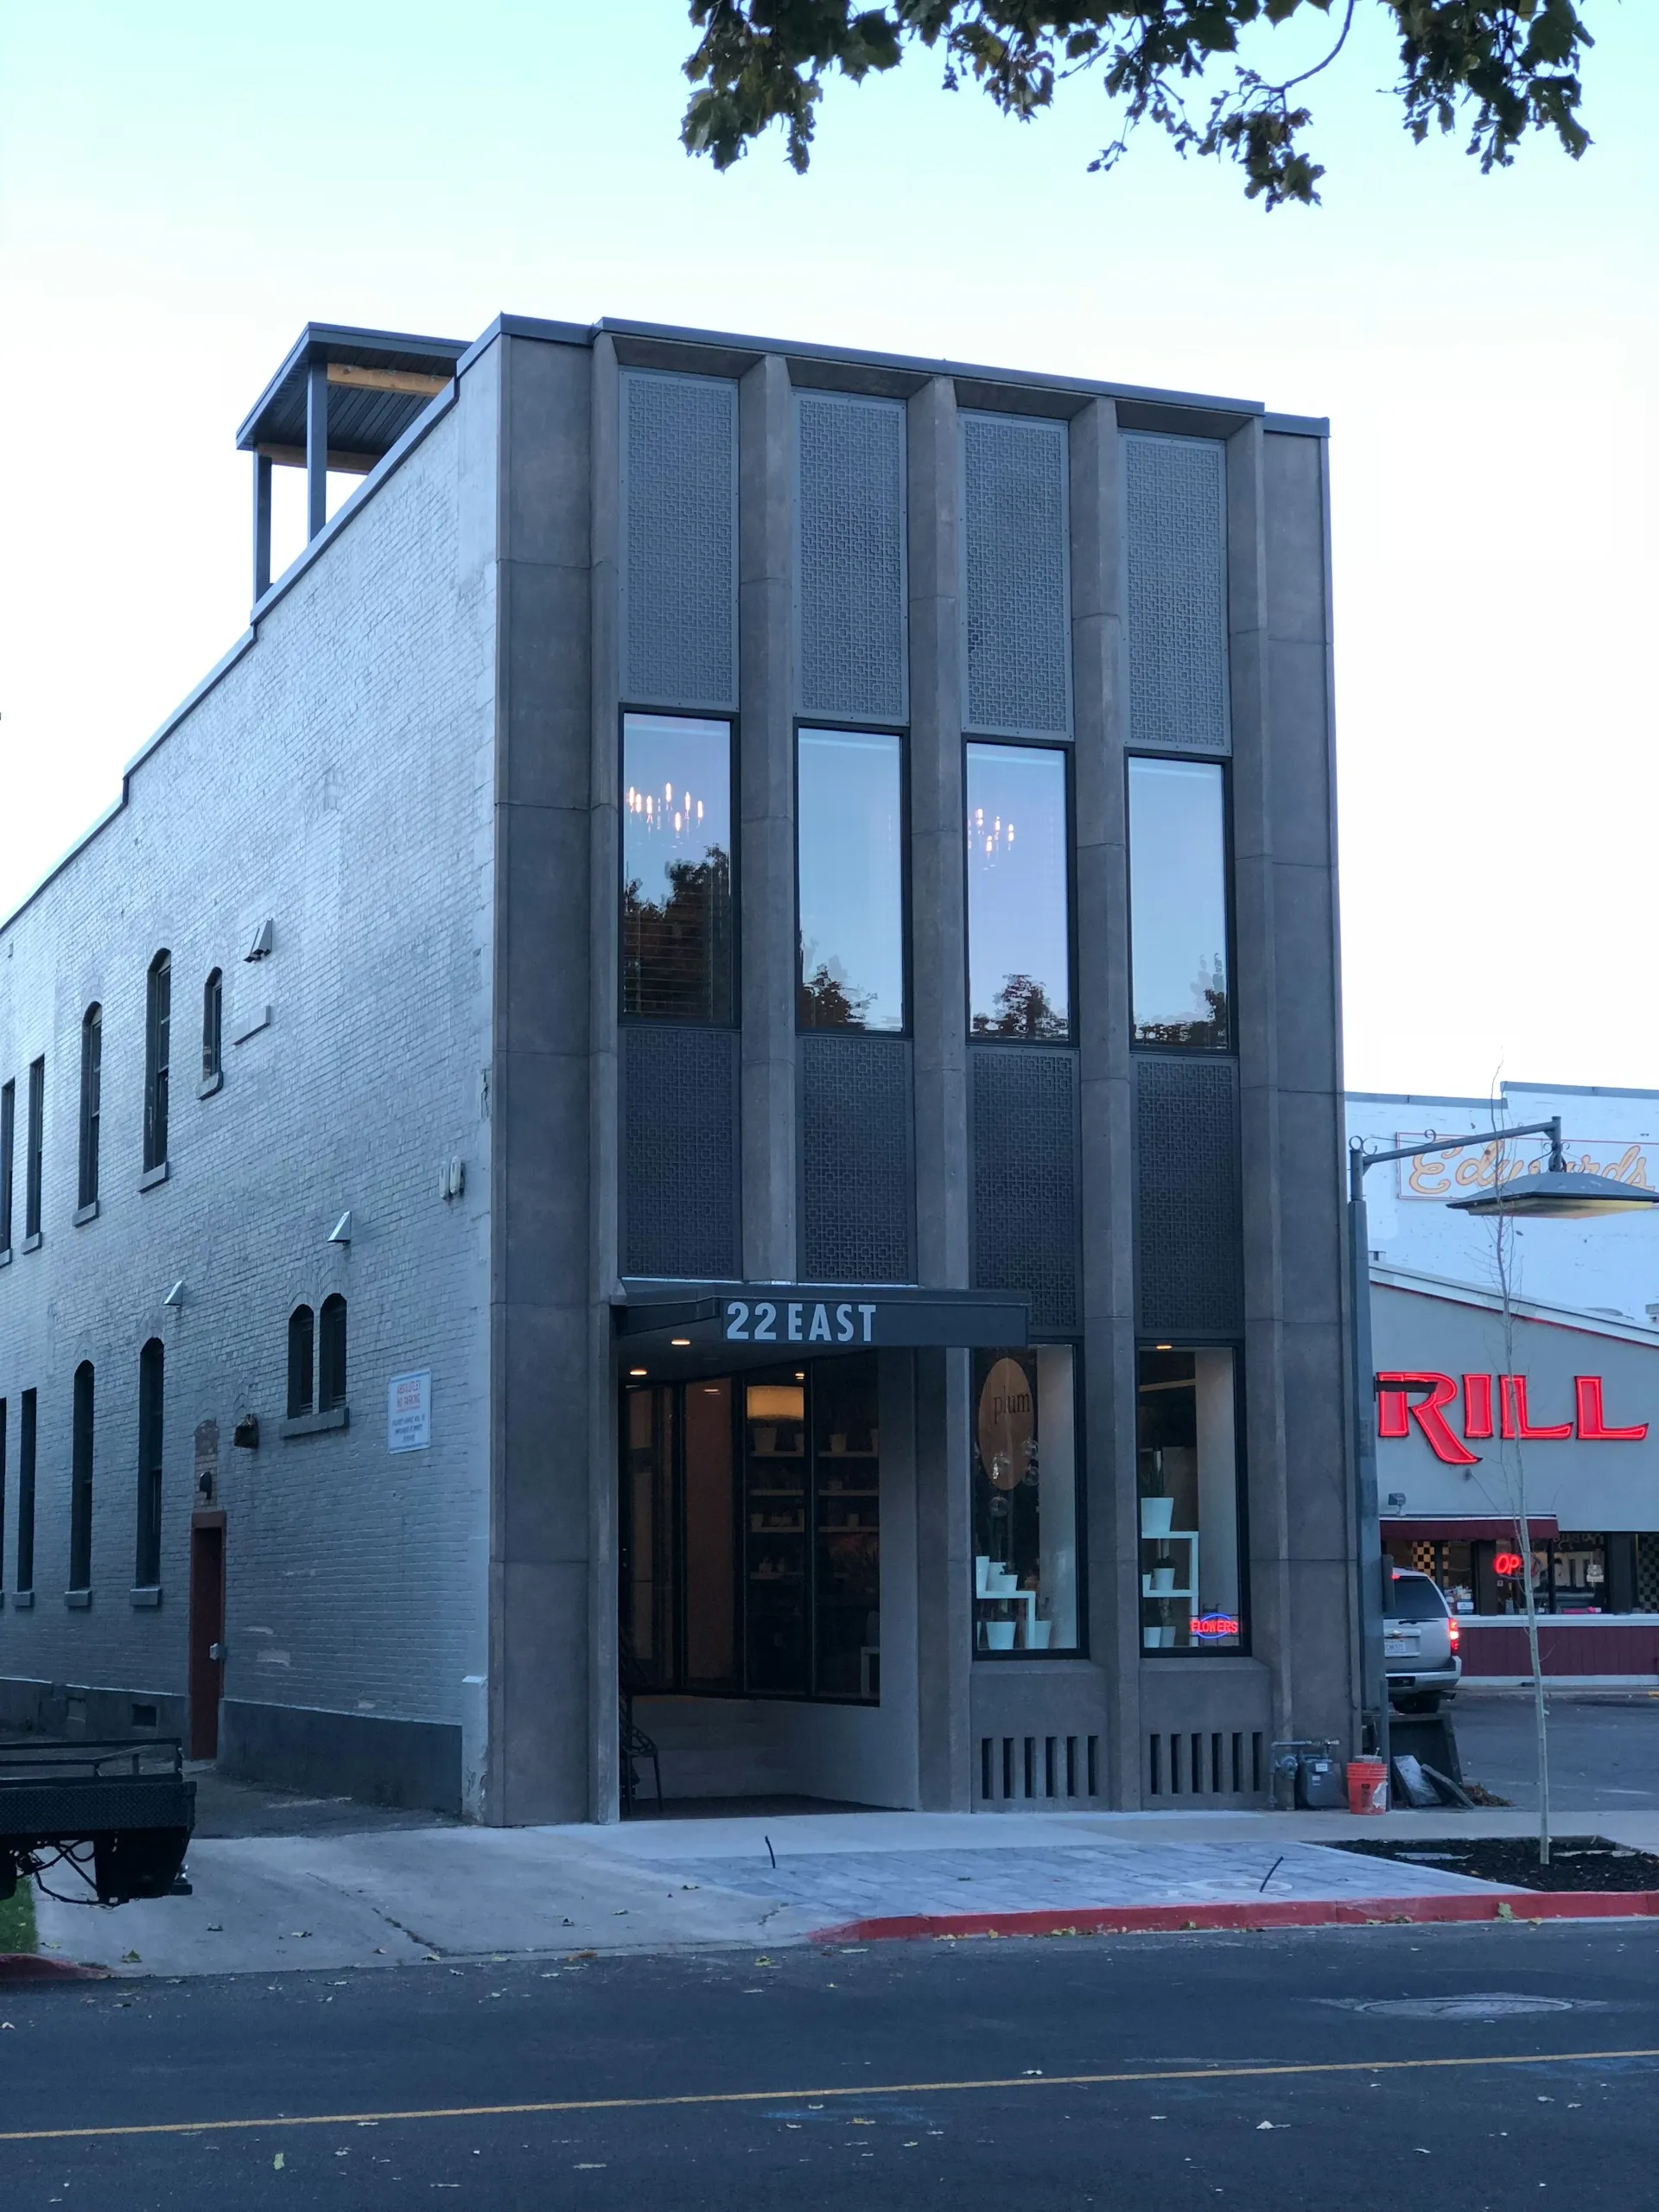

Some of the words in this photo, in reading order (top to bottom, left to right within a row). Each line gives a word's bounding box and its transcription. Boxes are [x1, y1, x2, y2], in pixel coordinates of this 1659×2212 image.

[1409, 1138, 1656, 1195] Edwrds
[727, 1301, 777, 1340] 22
[788, 1302, 876, 1342] EAST
[994, 1385, 1031, 1424] plum
[1190, 1618, 1238, 1633] FLOWERS
